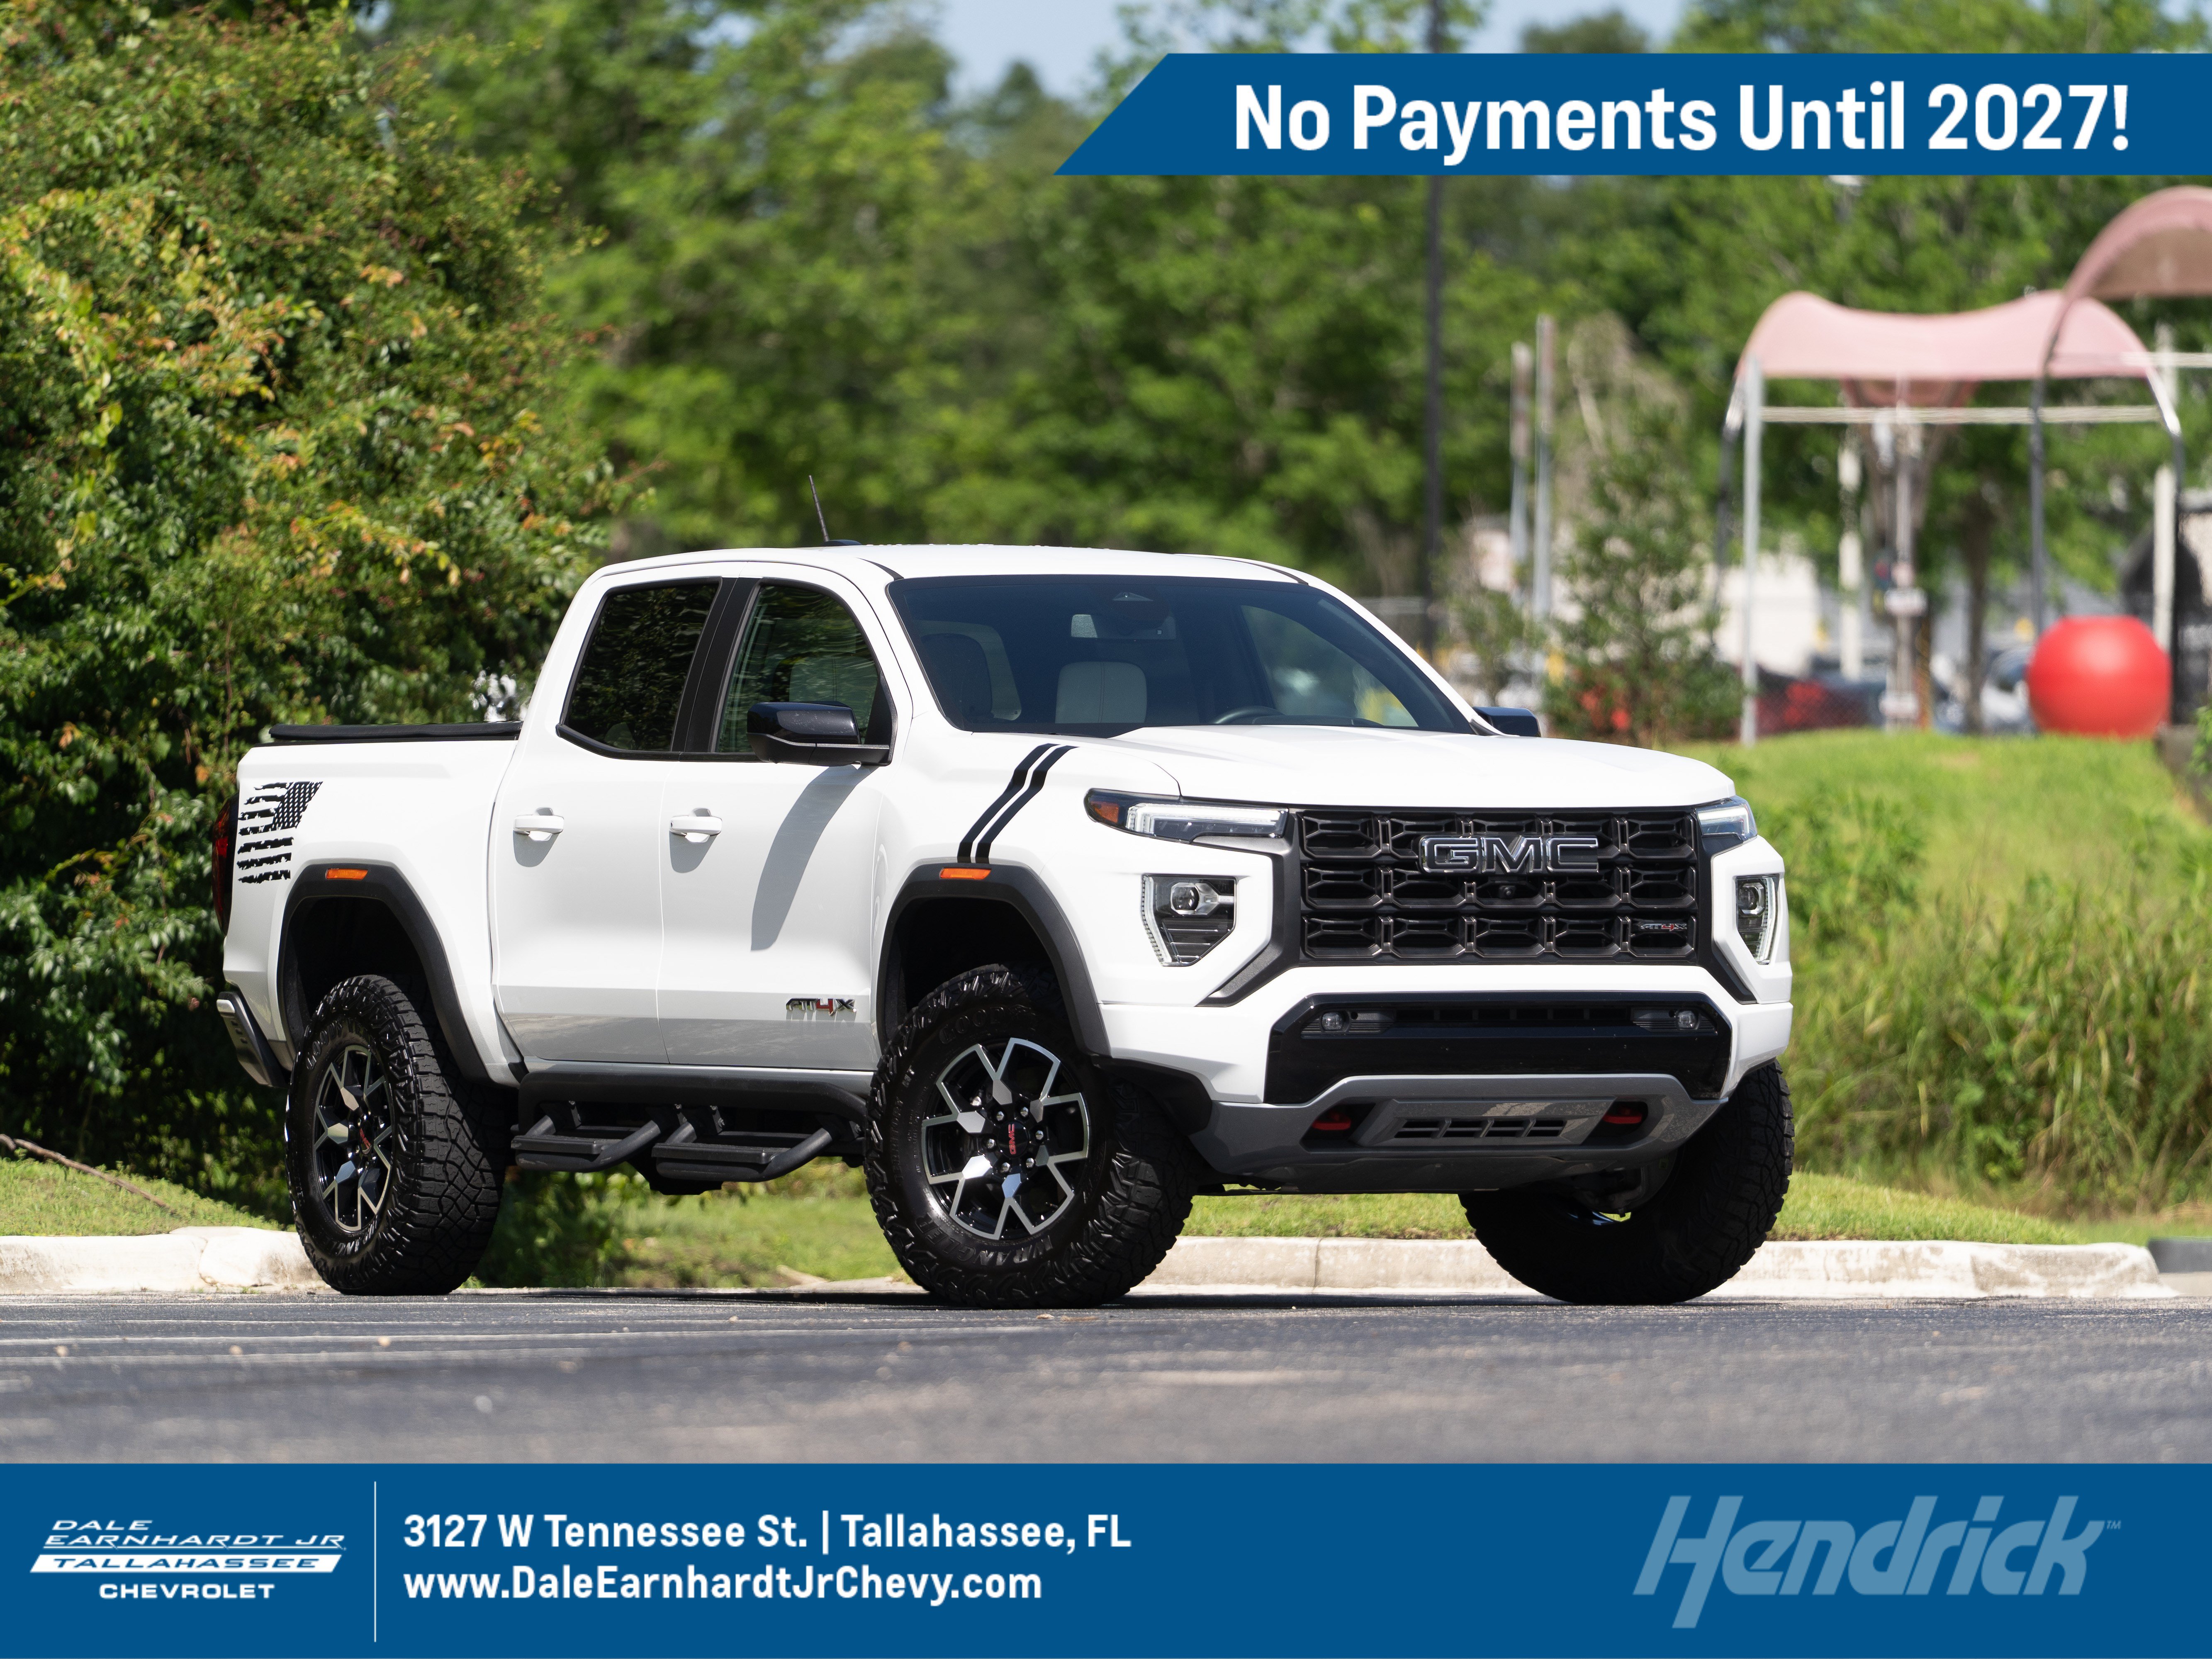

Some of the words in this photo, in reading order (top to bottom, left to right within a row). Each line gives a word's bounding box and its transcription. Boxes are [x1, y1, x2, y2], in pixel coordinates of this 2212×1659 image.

[1420, 835, 1599, 873] GMC
[786, 998, 856, 1016] AT4X
[914, 1212, 1054, 1266] WRANGLER
